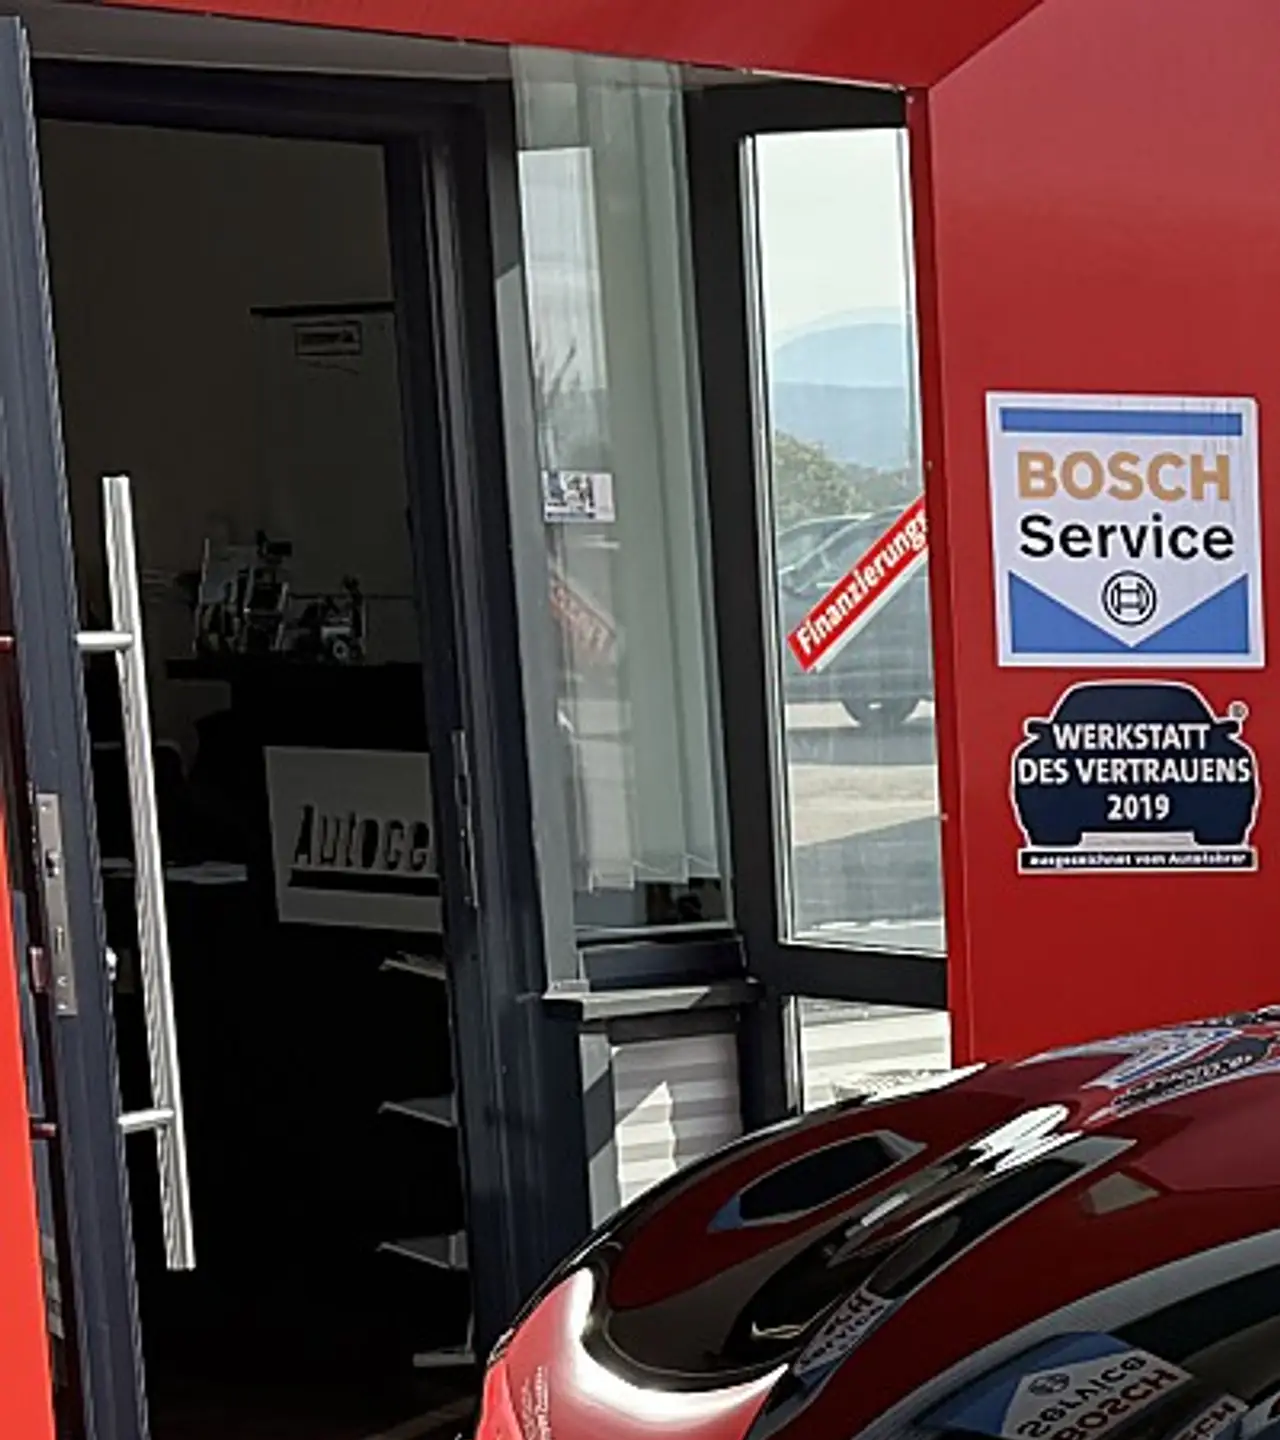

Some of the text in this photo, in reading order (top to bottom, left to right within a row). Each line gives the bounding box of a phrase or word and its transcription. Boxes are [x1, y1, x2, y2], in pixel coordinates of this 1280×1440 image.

[1016, 449, 1231, 501] BOSCH
[1019, 512, 1235, 560] Service
[796, 508, 928, 655] Finanzierung
[1052, 723, 1211, 750] WERKSTATT
[1018, 757, 1252, 784] DES VERTRAUENS
[1107, 794, 1171, 821] 2019
